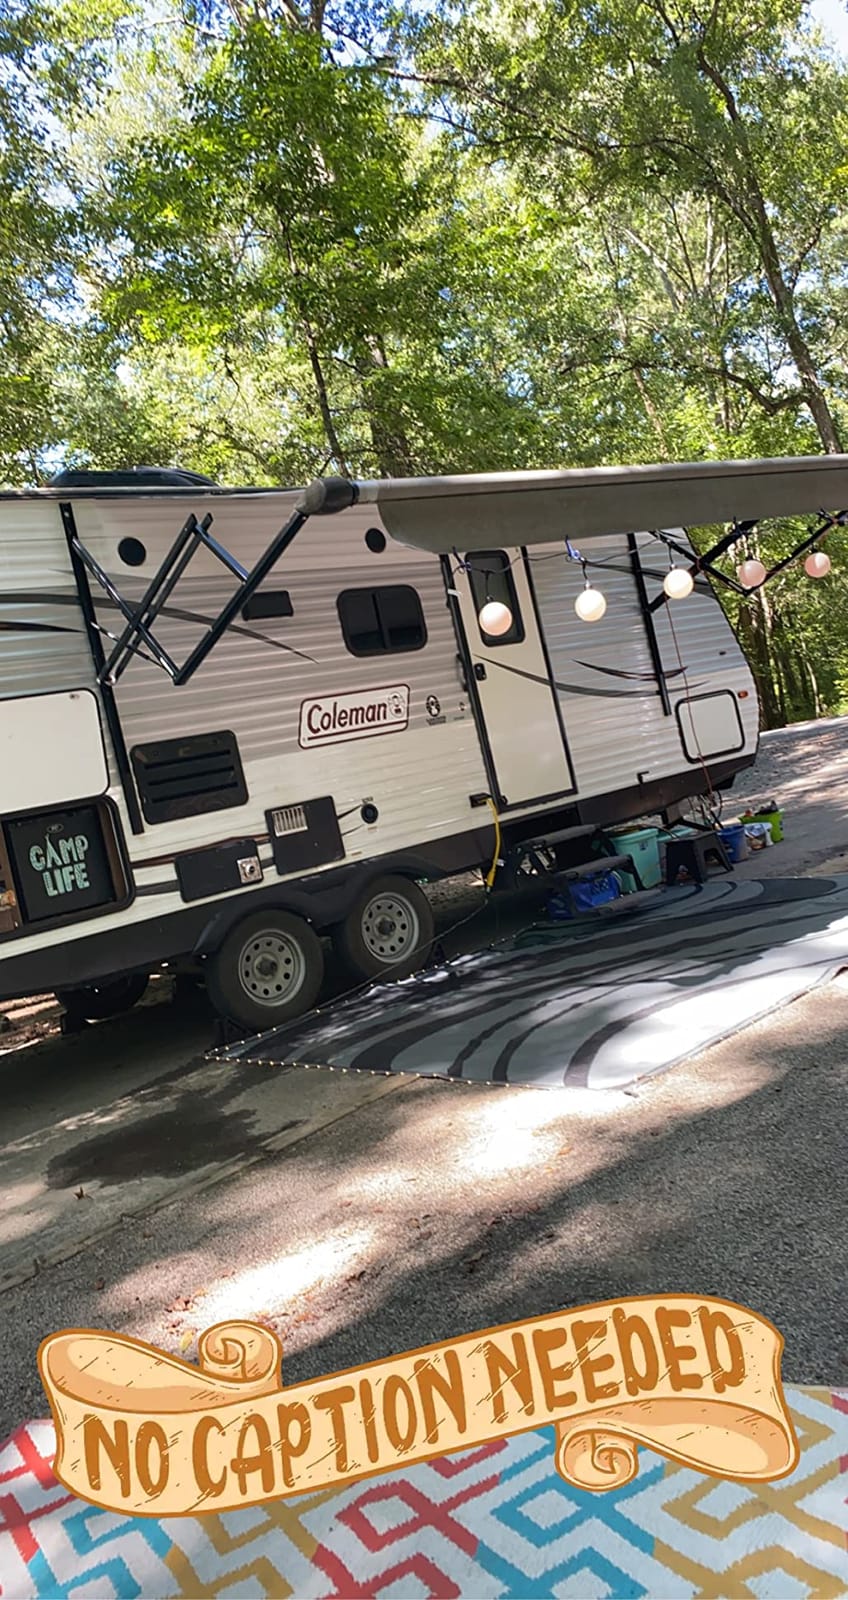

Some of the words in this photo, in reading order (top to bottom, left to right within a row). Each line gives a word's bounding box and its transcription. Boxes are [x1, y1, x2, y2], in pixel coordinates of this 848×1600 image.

[307, 701, 388, 734] Coleman
[29, 834, 89, 871] CAMP
[42, 862, 90, 897] LIFE
